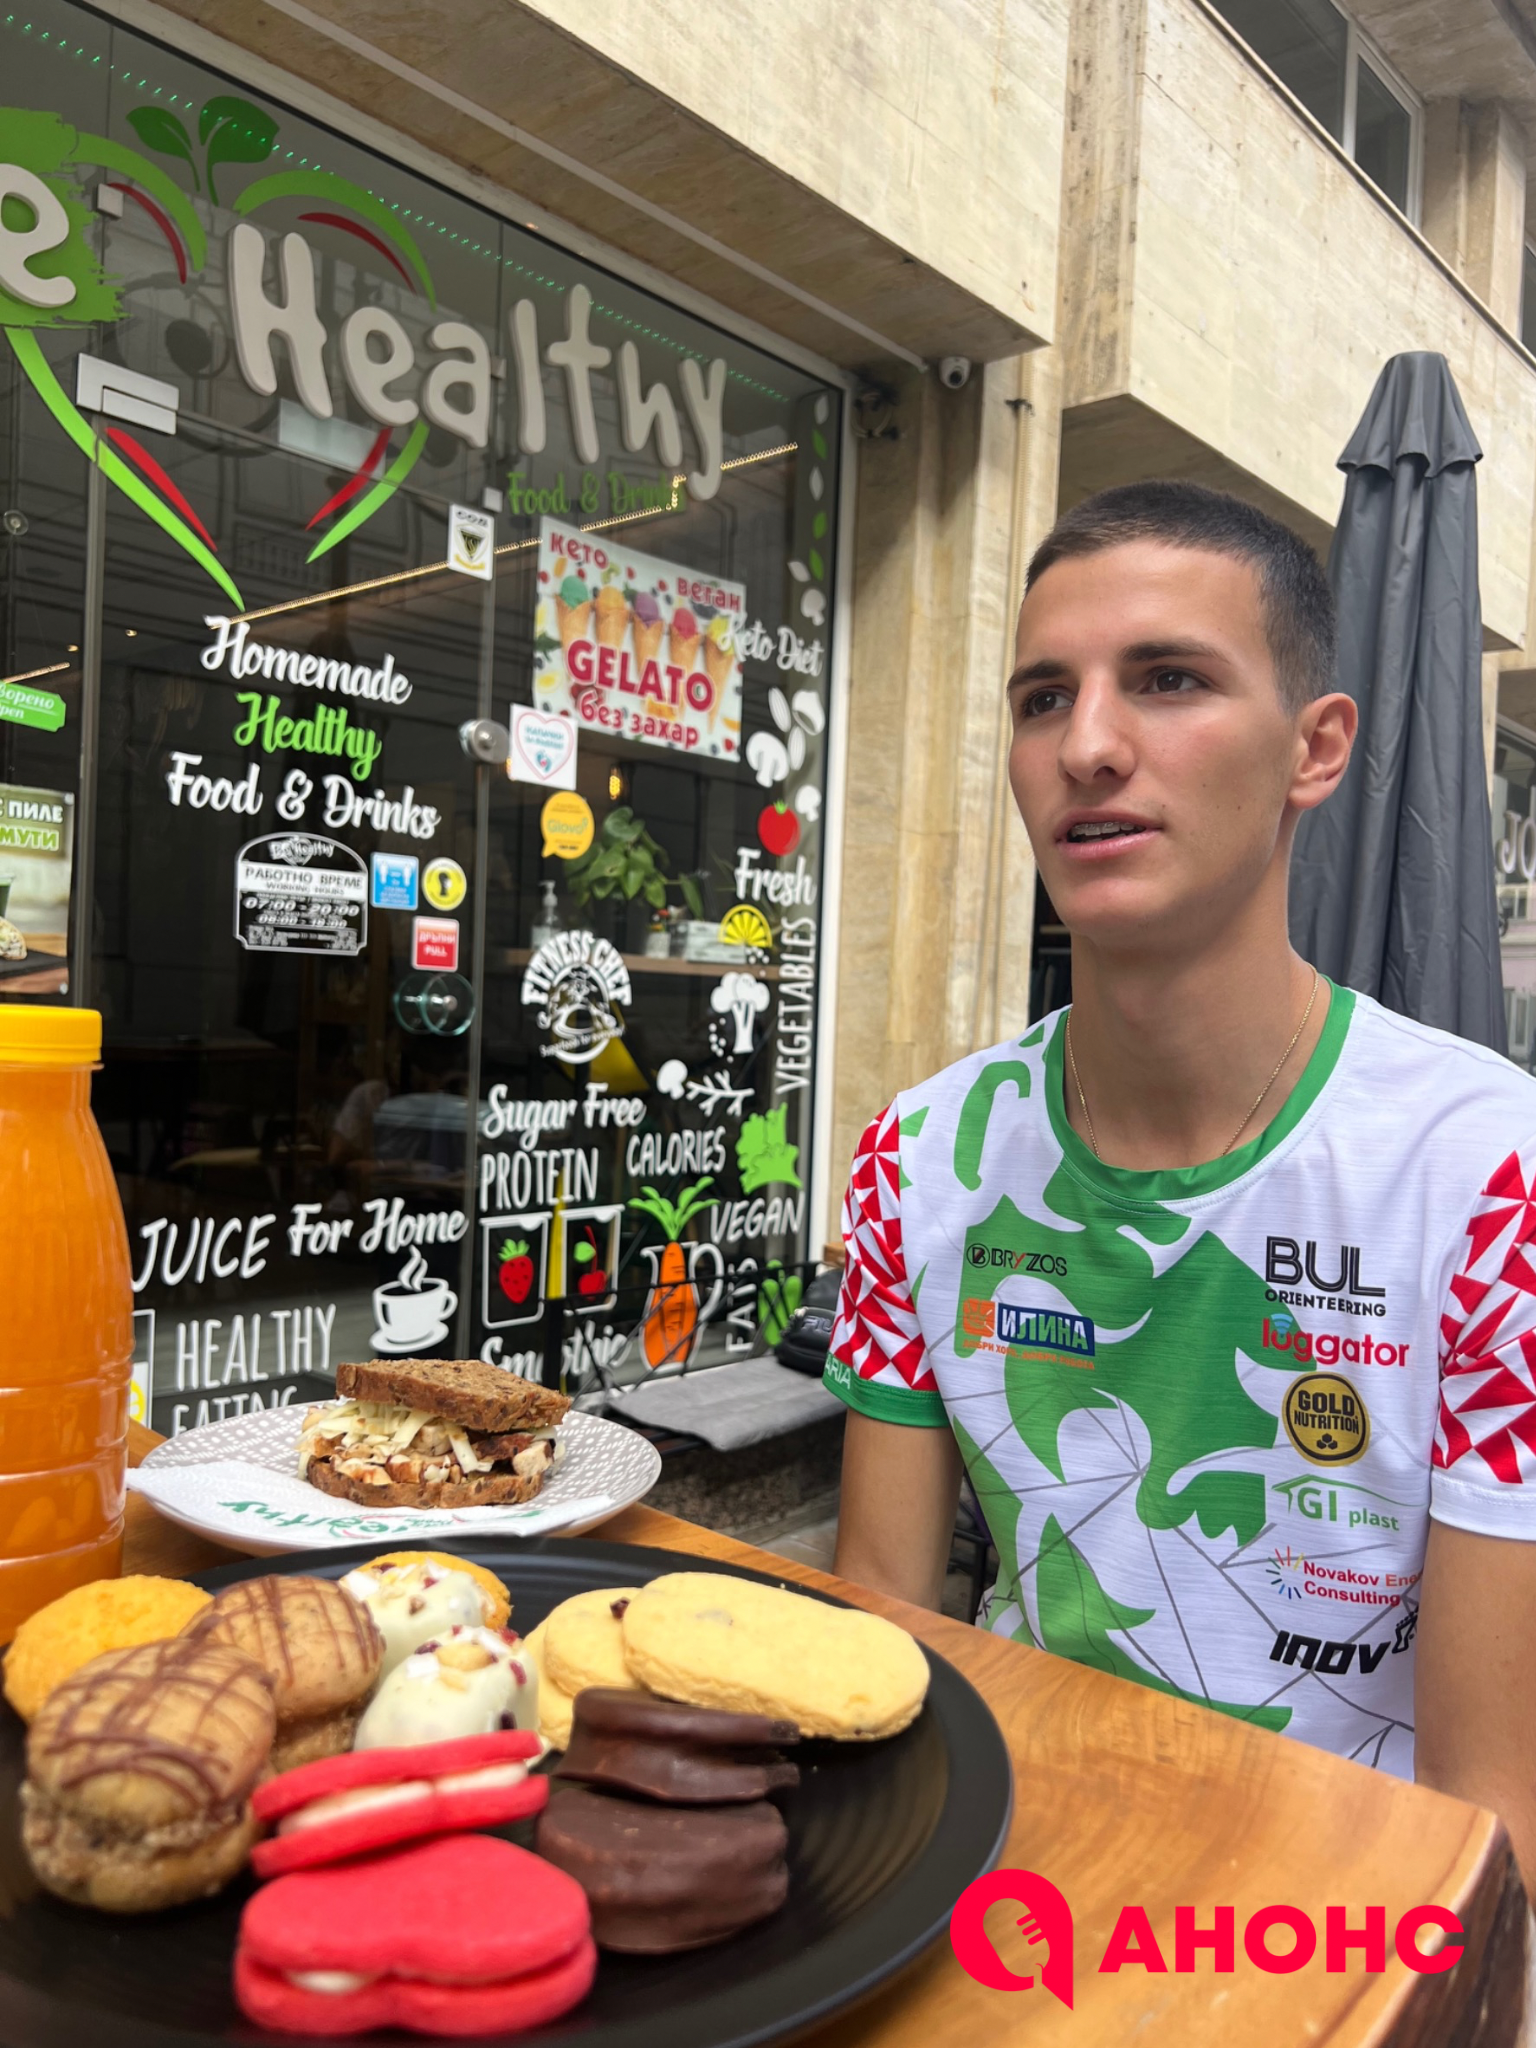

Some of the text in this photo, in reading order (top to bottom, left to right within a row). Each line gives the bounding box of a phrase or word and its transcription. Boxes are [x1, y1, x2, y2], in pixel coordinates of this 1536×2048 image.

[0, 163, 727, 500] e Healthy
[507, 471, 570, 515] Food
[581, 471, 600, 514] &
[201, 615, 412, 705] Homemade
[717, 611, 824, 677] Keto Diet
[567, 640, 715, 712] GELATO
[233, 692, 382, 781] Healthy
[579, 689, 699, 748] без захар
[8, 799, 63, 824] ПИЛЕ
[167, 751, 441, 840] Food & Drinks
[246, 866, 313, 884] РАБОТНО
[319, 874, 363, 890] ВРЕМЕ
[733, 846, 817, 907] Fresh
[423, 944, 448, 957] PULL
[521, 929, 632, 1006] FITNESS CHEF
[775, 917, 817, 1096] VEGETABLES
[482, 1082, 647, 1152] Sugar Free
[479, 1147, 599, 1212] PROTEIN
[626, 1126, 727, 1177] CALORIES
[131, 1196, 469, 1293] JUICE For Home
[710, 1191, 806, 1244] VEGAN
[991, 1247, 1068, 1277] BRYZOS
[1265, 1235, 1386, 1298] BUL
[802, 1315, 833, 1333] FIL
[1001, 1307, 1089, 1350] ИЛИНА
[1264, 1288, 1387, 1318] ORIENTEERING
[176, 1303, 337, 1392] HEALTHY
[480, 1320, 633, 1384] Smthie
[1293, 1409, 1360, 1435] NUTRITION
[1298, 1389, 1356, 1418] GOLD
[1297, 1486, 1400, 1531] GI plast
[1303, 1560, 1422, 1587] Novakov Ene
[1304, 1581, 1401, 1607] Consulting
